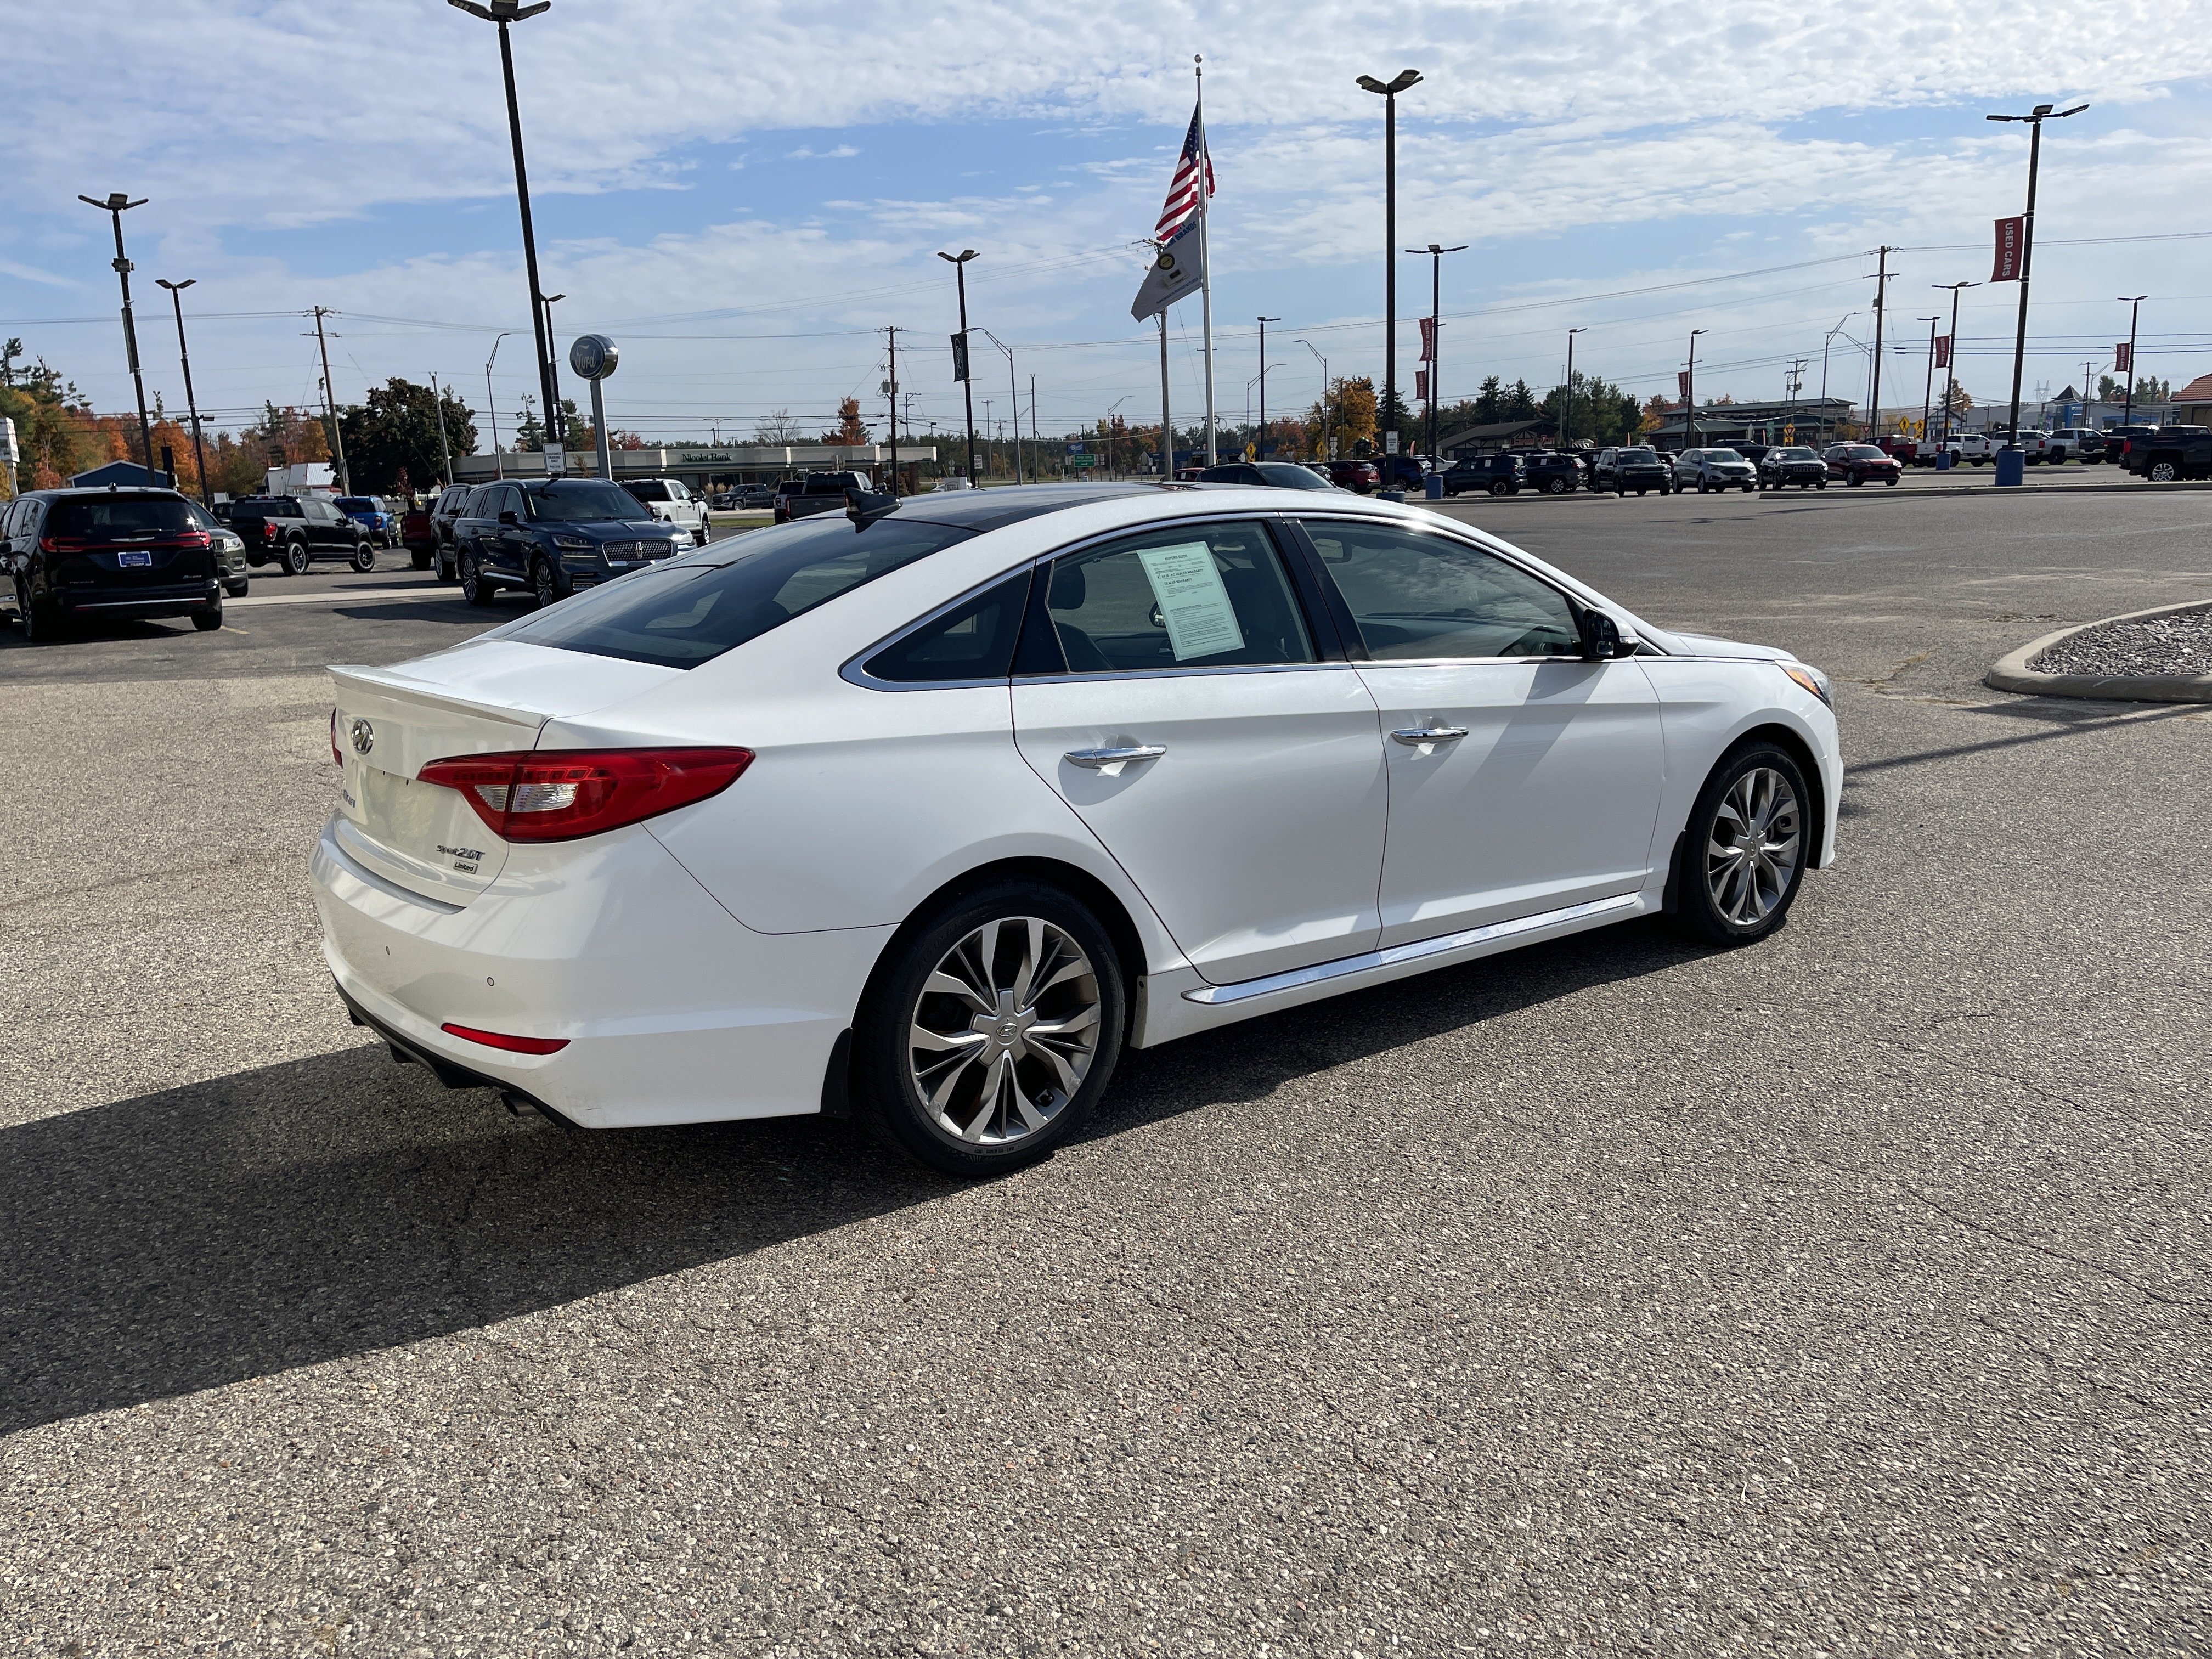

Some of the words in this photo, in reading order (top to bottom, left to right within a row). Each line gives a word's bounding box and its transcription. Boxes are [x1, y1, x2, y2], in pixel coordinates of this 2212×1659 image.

[1175, 221, 1197, 241] BRANDS
[2005, 222, 2013, 249] USED
[2002, 251, 2013, 277] CARS
[575, 345, 596, 370] Ford
[681, 453, 709, 462] Nicolet
[710, 453, 731, 461] Bank
[454, 861, 475, 872] Limited
